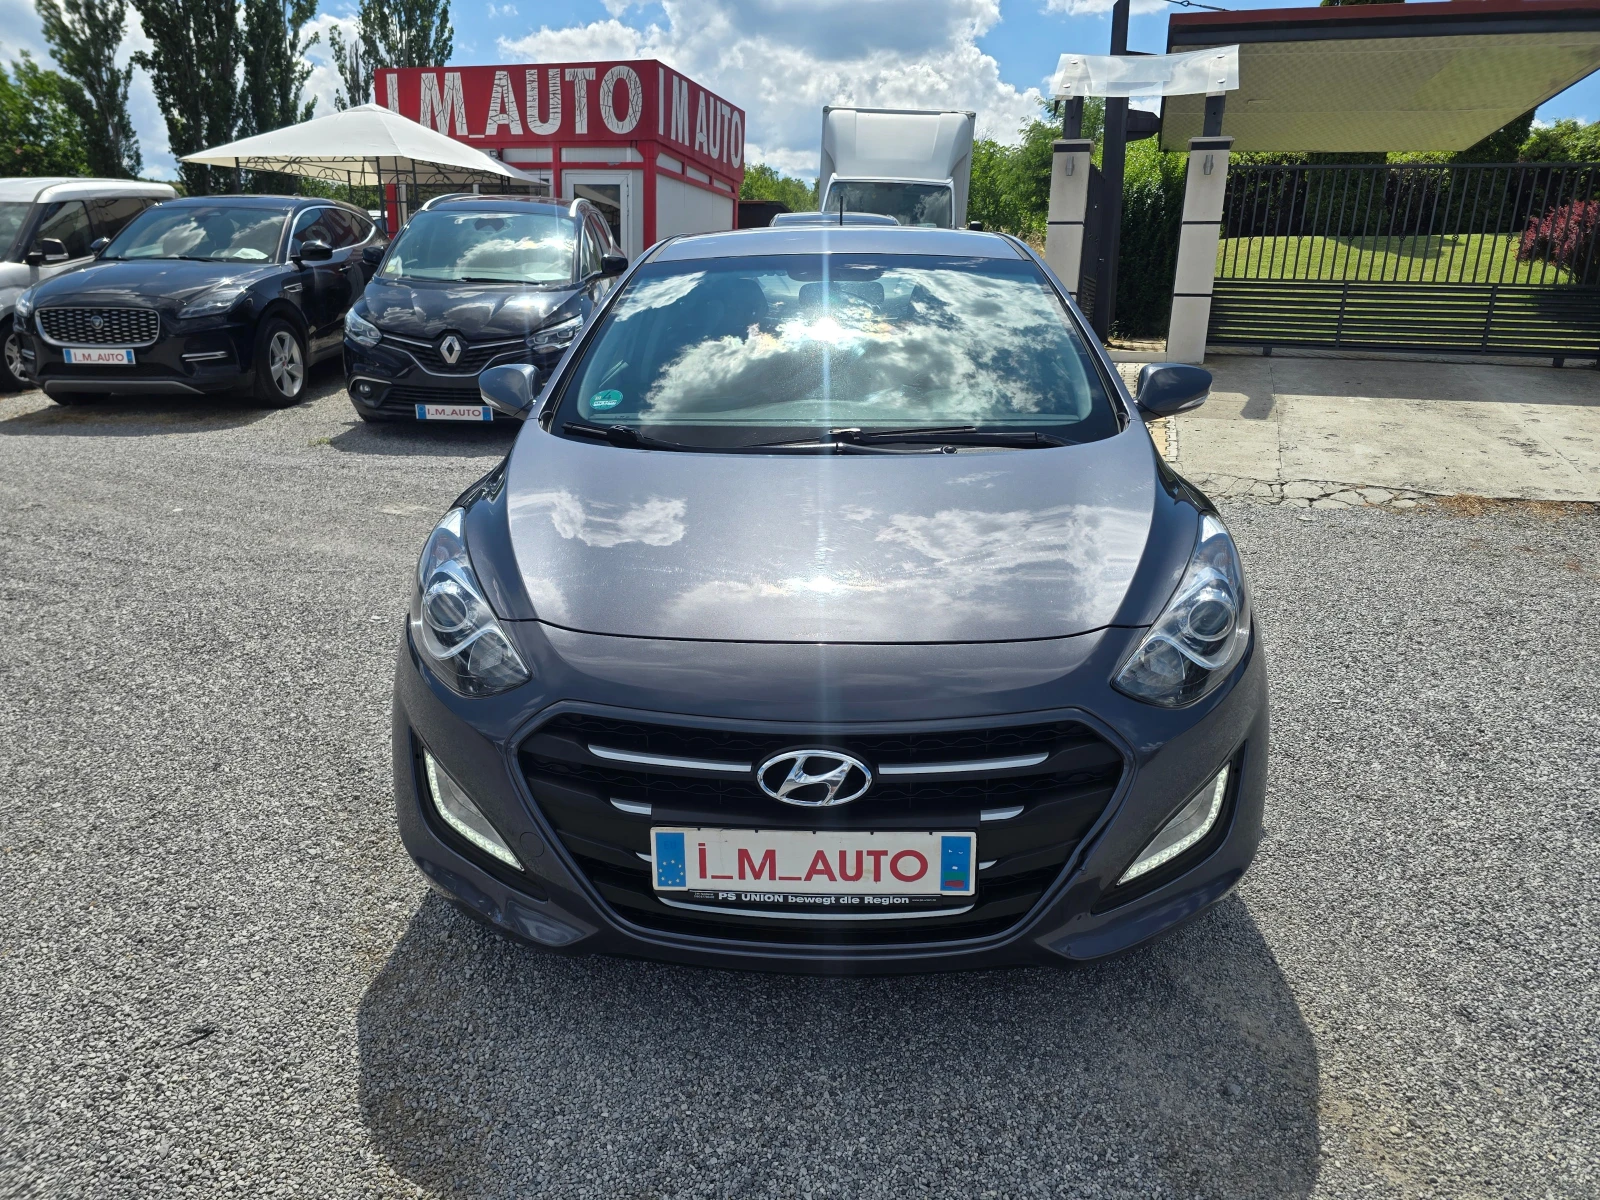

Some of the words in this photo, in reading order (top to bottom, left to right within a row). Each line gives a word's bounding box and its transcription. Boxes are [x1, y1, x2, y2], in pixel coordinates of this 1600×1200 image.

[659, 67, 664, 136] I
[671, 75, 689, 146] M
[695, 90, 742, 168] AUTO
[74, 352, 124, 362] I_M_AUTO
[427, 408, 482, 417] I_M_AUTO
[718, 892, 737, 901] PS
[741, 893, 783, 903] UNION
[788, 895, 836, 904] bewegt
[839, 896, 860, 904] die
[864, 896, 909, 905] Region
